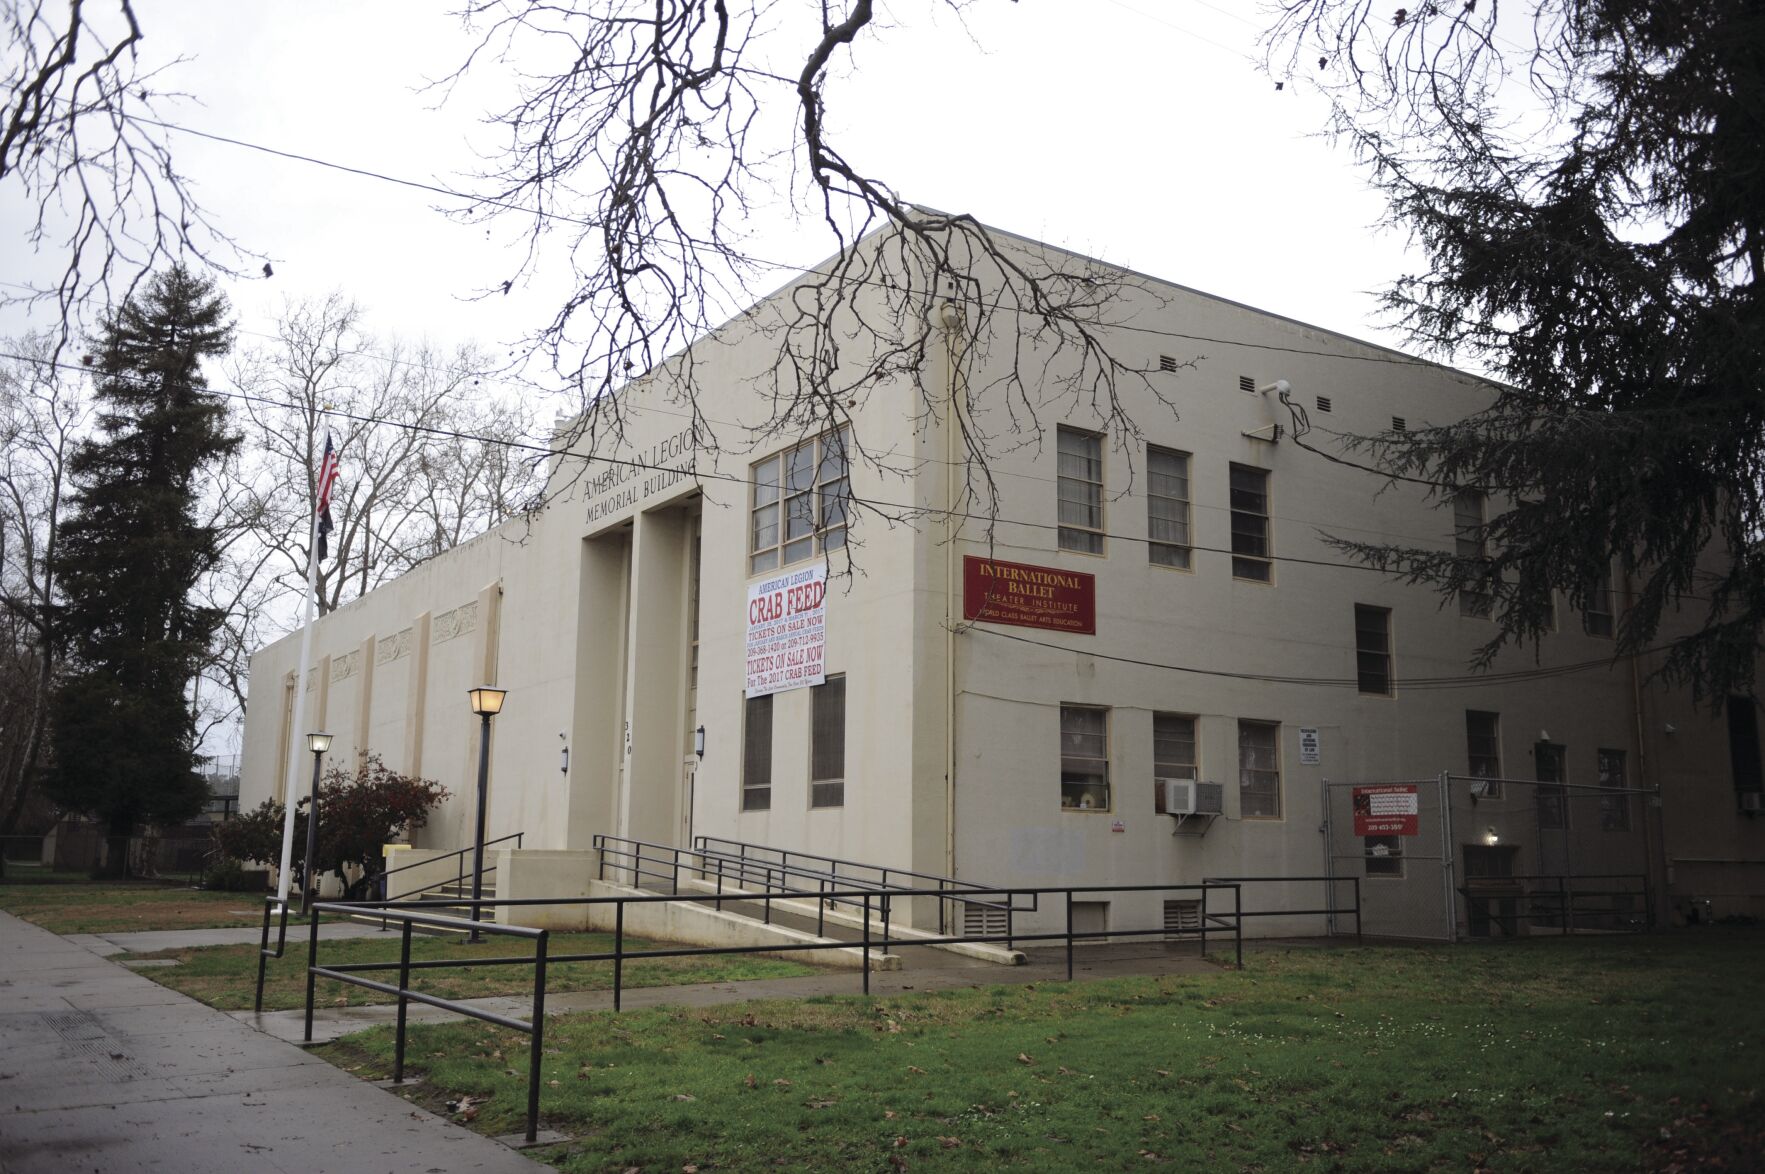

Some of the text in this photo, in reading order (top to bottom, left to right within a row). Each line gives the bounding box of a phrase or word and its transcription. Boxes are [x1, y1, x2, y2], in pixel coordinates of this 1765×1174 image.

[583, 420, 704, 503] AMERICAN LEGION
[586, 457, 696, 525] MEMORIAL BUILDING
[759, 570, 813, 594] AMERICAN LEGION
[980, 564, 1081, 589] INTERNATIONAL
[984, 592, 1079, 612] THEATER INSTITUTE
[1009, 582, 1056, 598] BALLET
[750, 580, 823, 626] CRAB FEED
[749, 615, 823, 642] TICKETS ON SALE NOW
[1001, 611, 1019, 619] CLASS
[1020, 614, 1037, 622] BALLET
[1053, 618, 1083, 627] EDUCATION
[748, 645, 823, 675] TICKETS ON SALE NOW
[748, 677, 756, 687] For
[758, 675, 767, 685] The
[769, 671, 783, 683] 2017
[785, 667, 802, 680] CRAB
[804, 663, 821, 676] FEED
